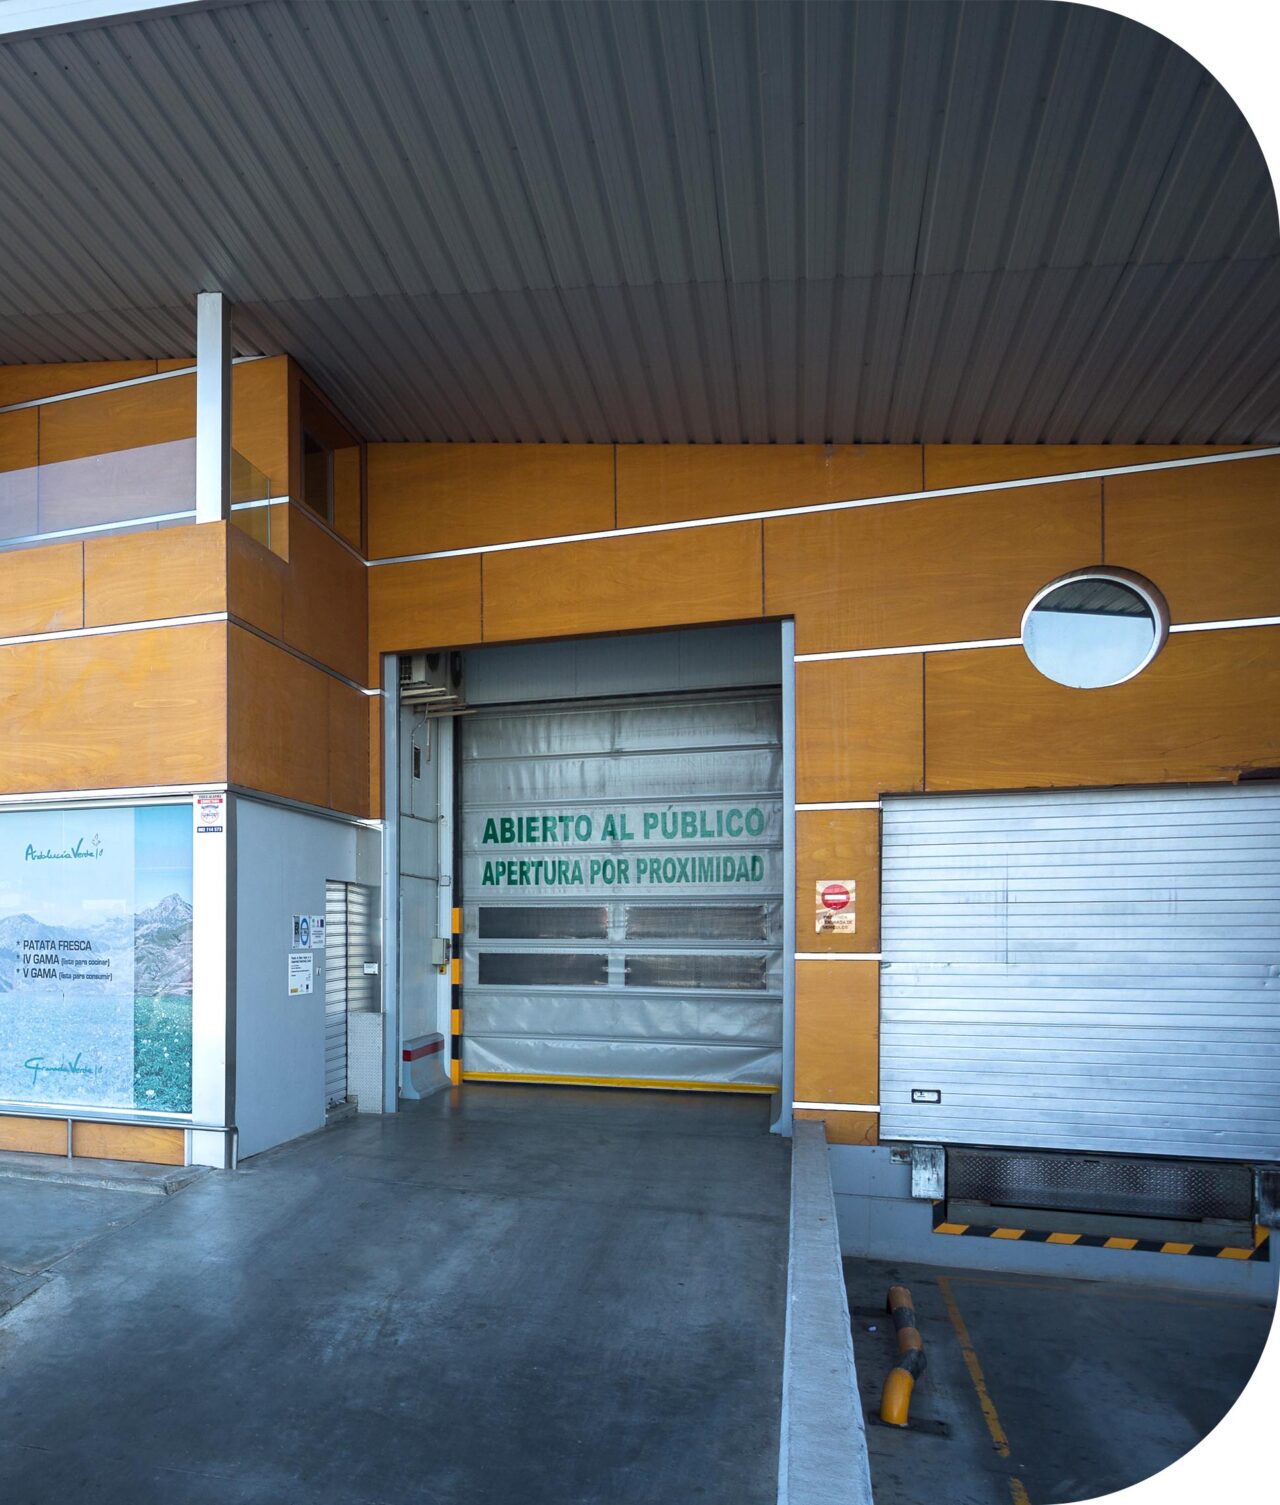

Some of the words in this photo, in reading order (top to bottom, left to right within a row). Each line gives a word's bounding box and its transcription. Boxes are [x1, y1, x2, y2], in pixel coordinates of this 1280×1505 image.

[482, 814, 593, 844] ABIERTO
[601, 812, 634, 841] AL
[643, 805, 765, 840] PÚBLICO
[481, 858, 584, 886] APERTURA
[589, 858, 630, 885] POR
[636, 855, 765, 884] PROXIMIDAD
[23, 940, 56, 951] PATATA
[58, 940, 92, 951] FRESCA
[23, 953, 31, 965] IV
[33, 954, 60, 965] GAMA
[23, 968, 29, 978] V
[31, 968, 57, 978] GAMA
